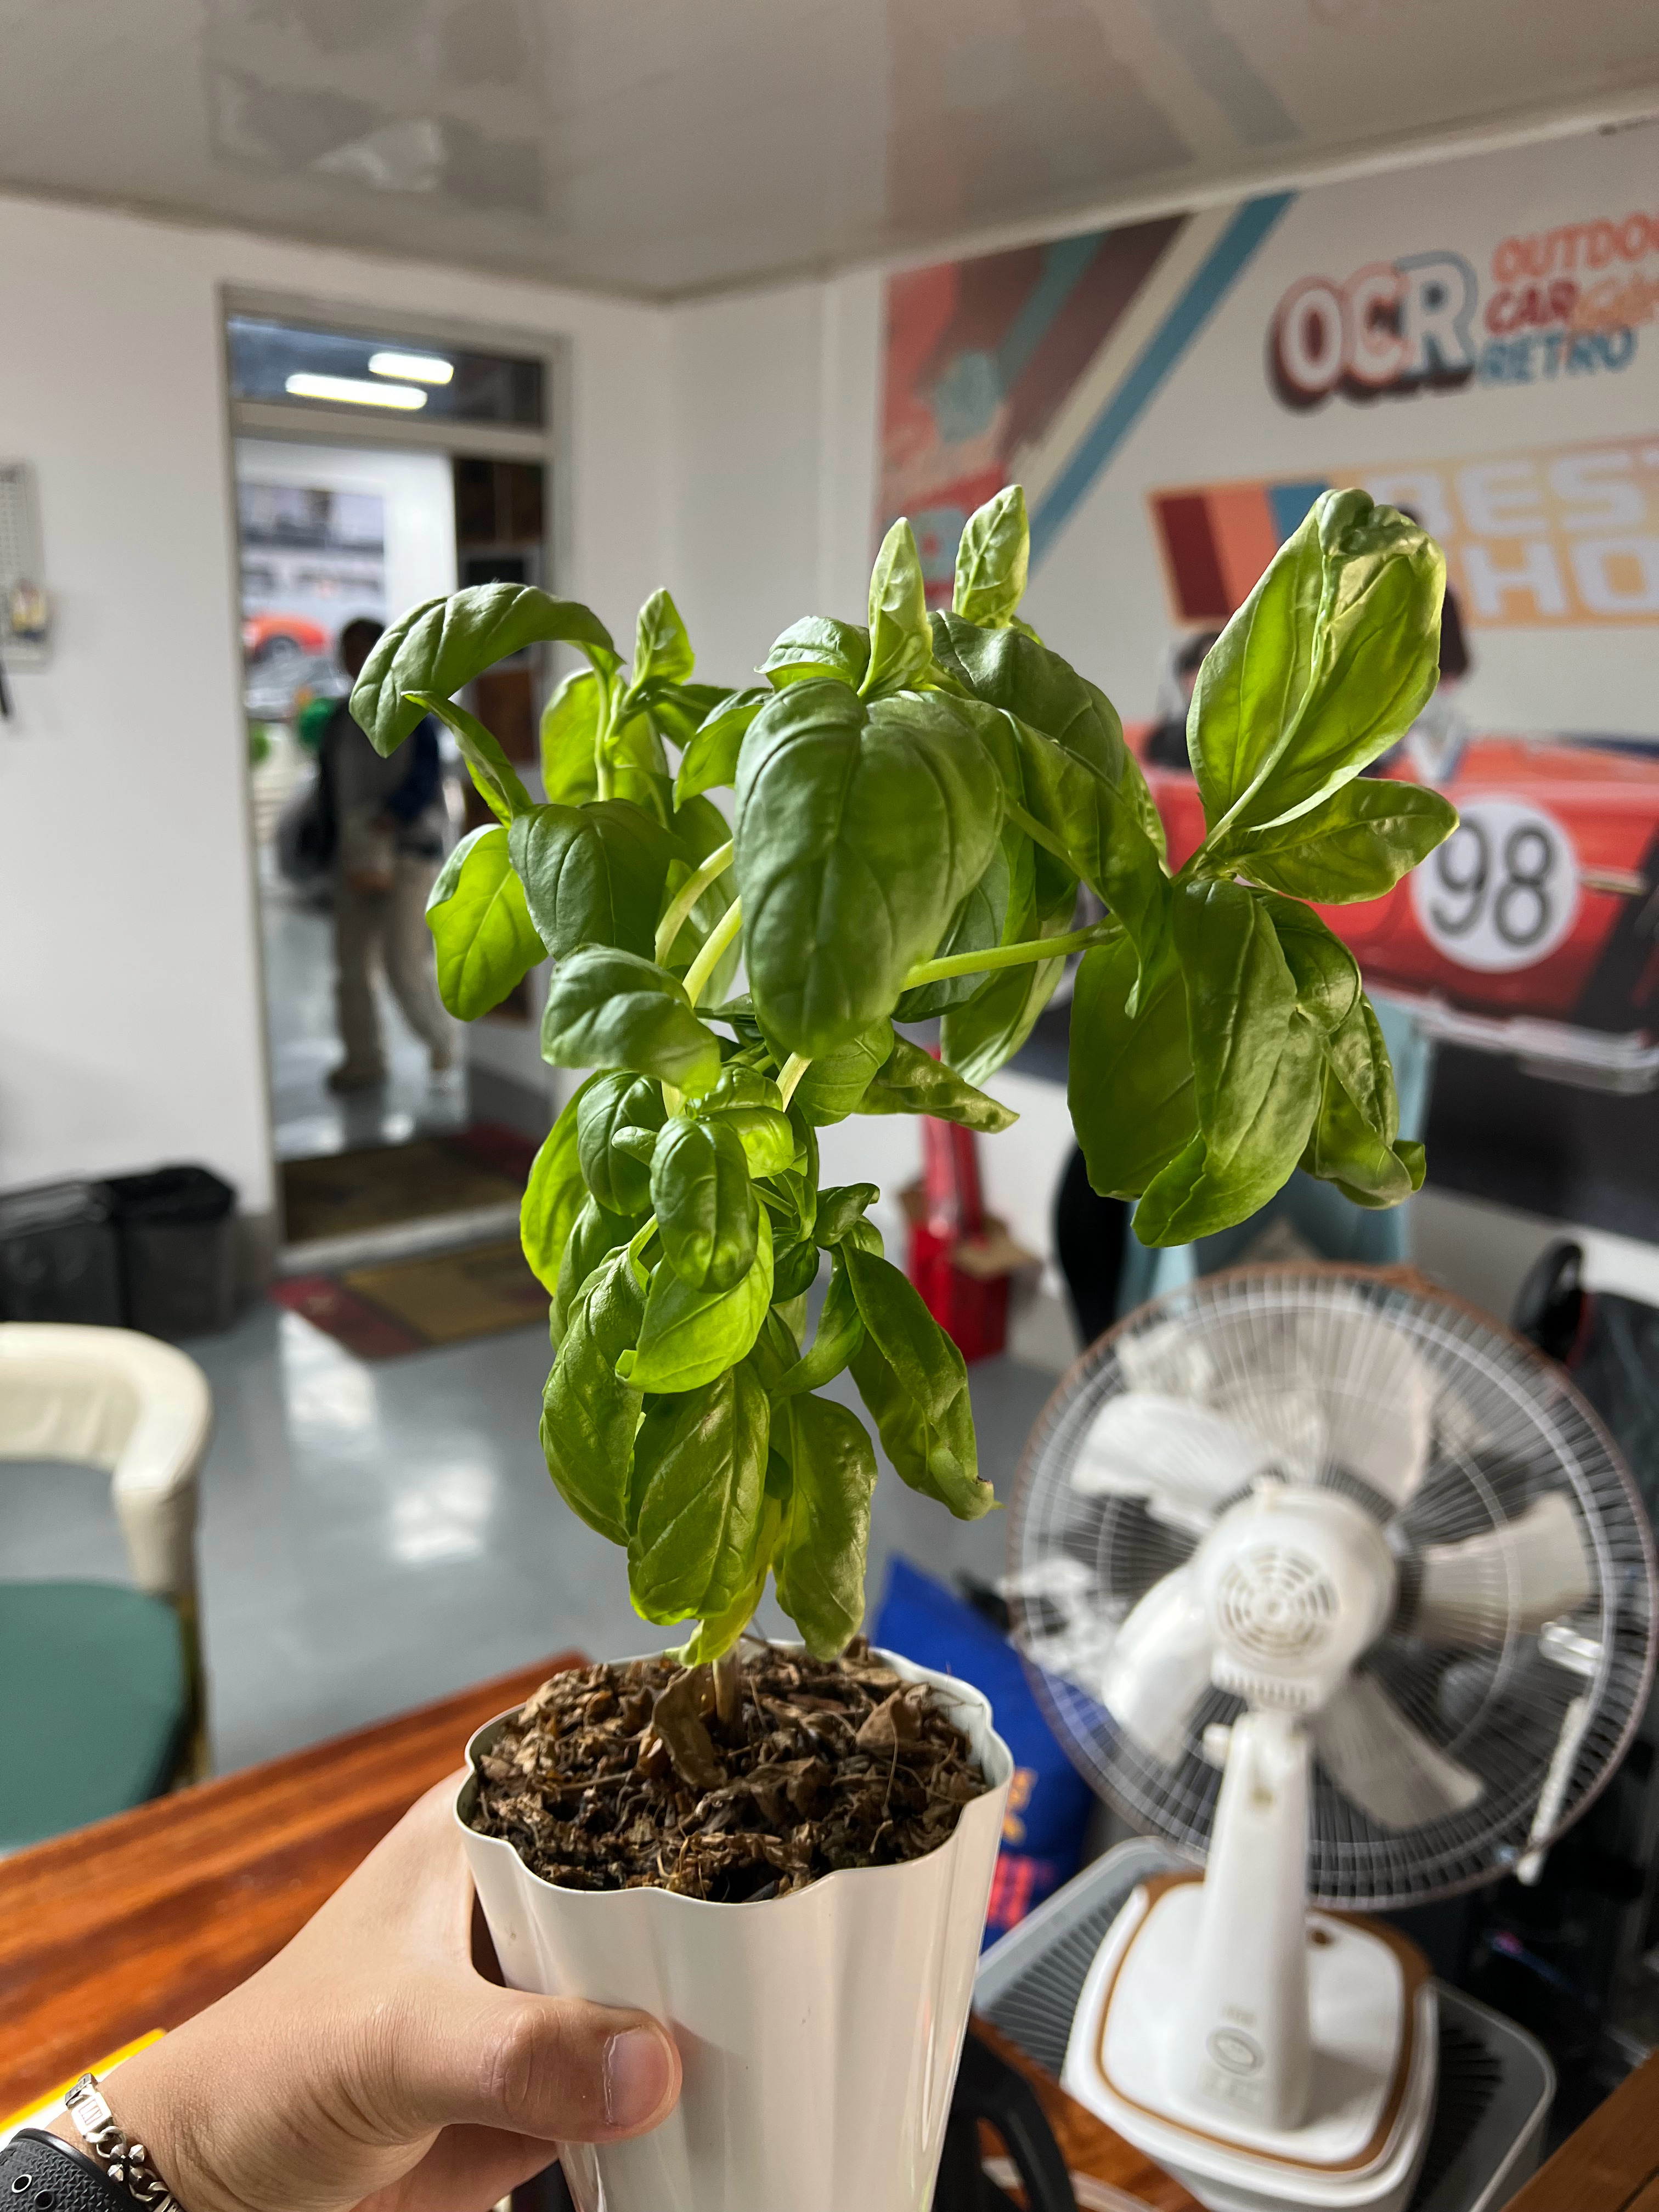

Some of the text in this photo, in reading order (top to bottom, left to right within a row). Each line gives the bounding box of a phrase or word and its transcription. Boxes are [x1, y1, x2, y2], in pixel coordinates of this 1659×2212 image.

[1264, 250, 1479, 416] OCR
[1485, 280, 1580, 337] CAR
[1480, 326, 1638, 386] RETRO
[1363, 448, 1659, 537] BES
[1430, 817, 1557, 949] 98
